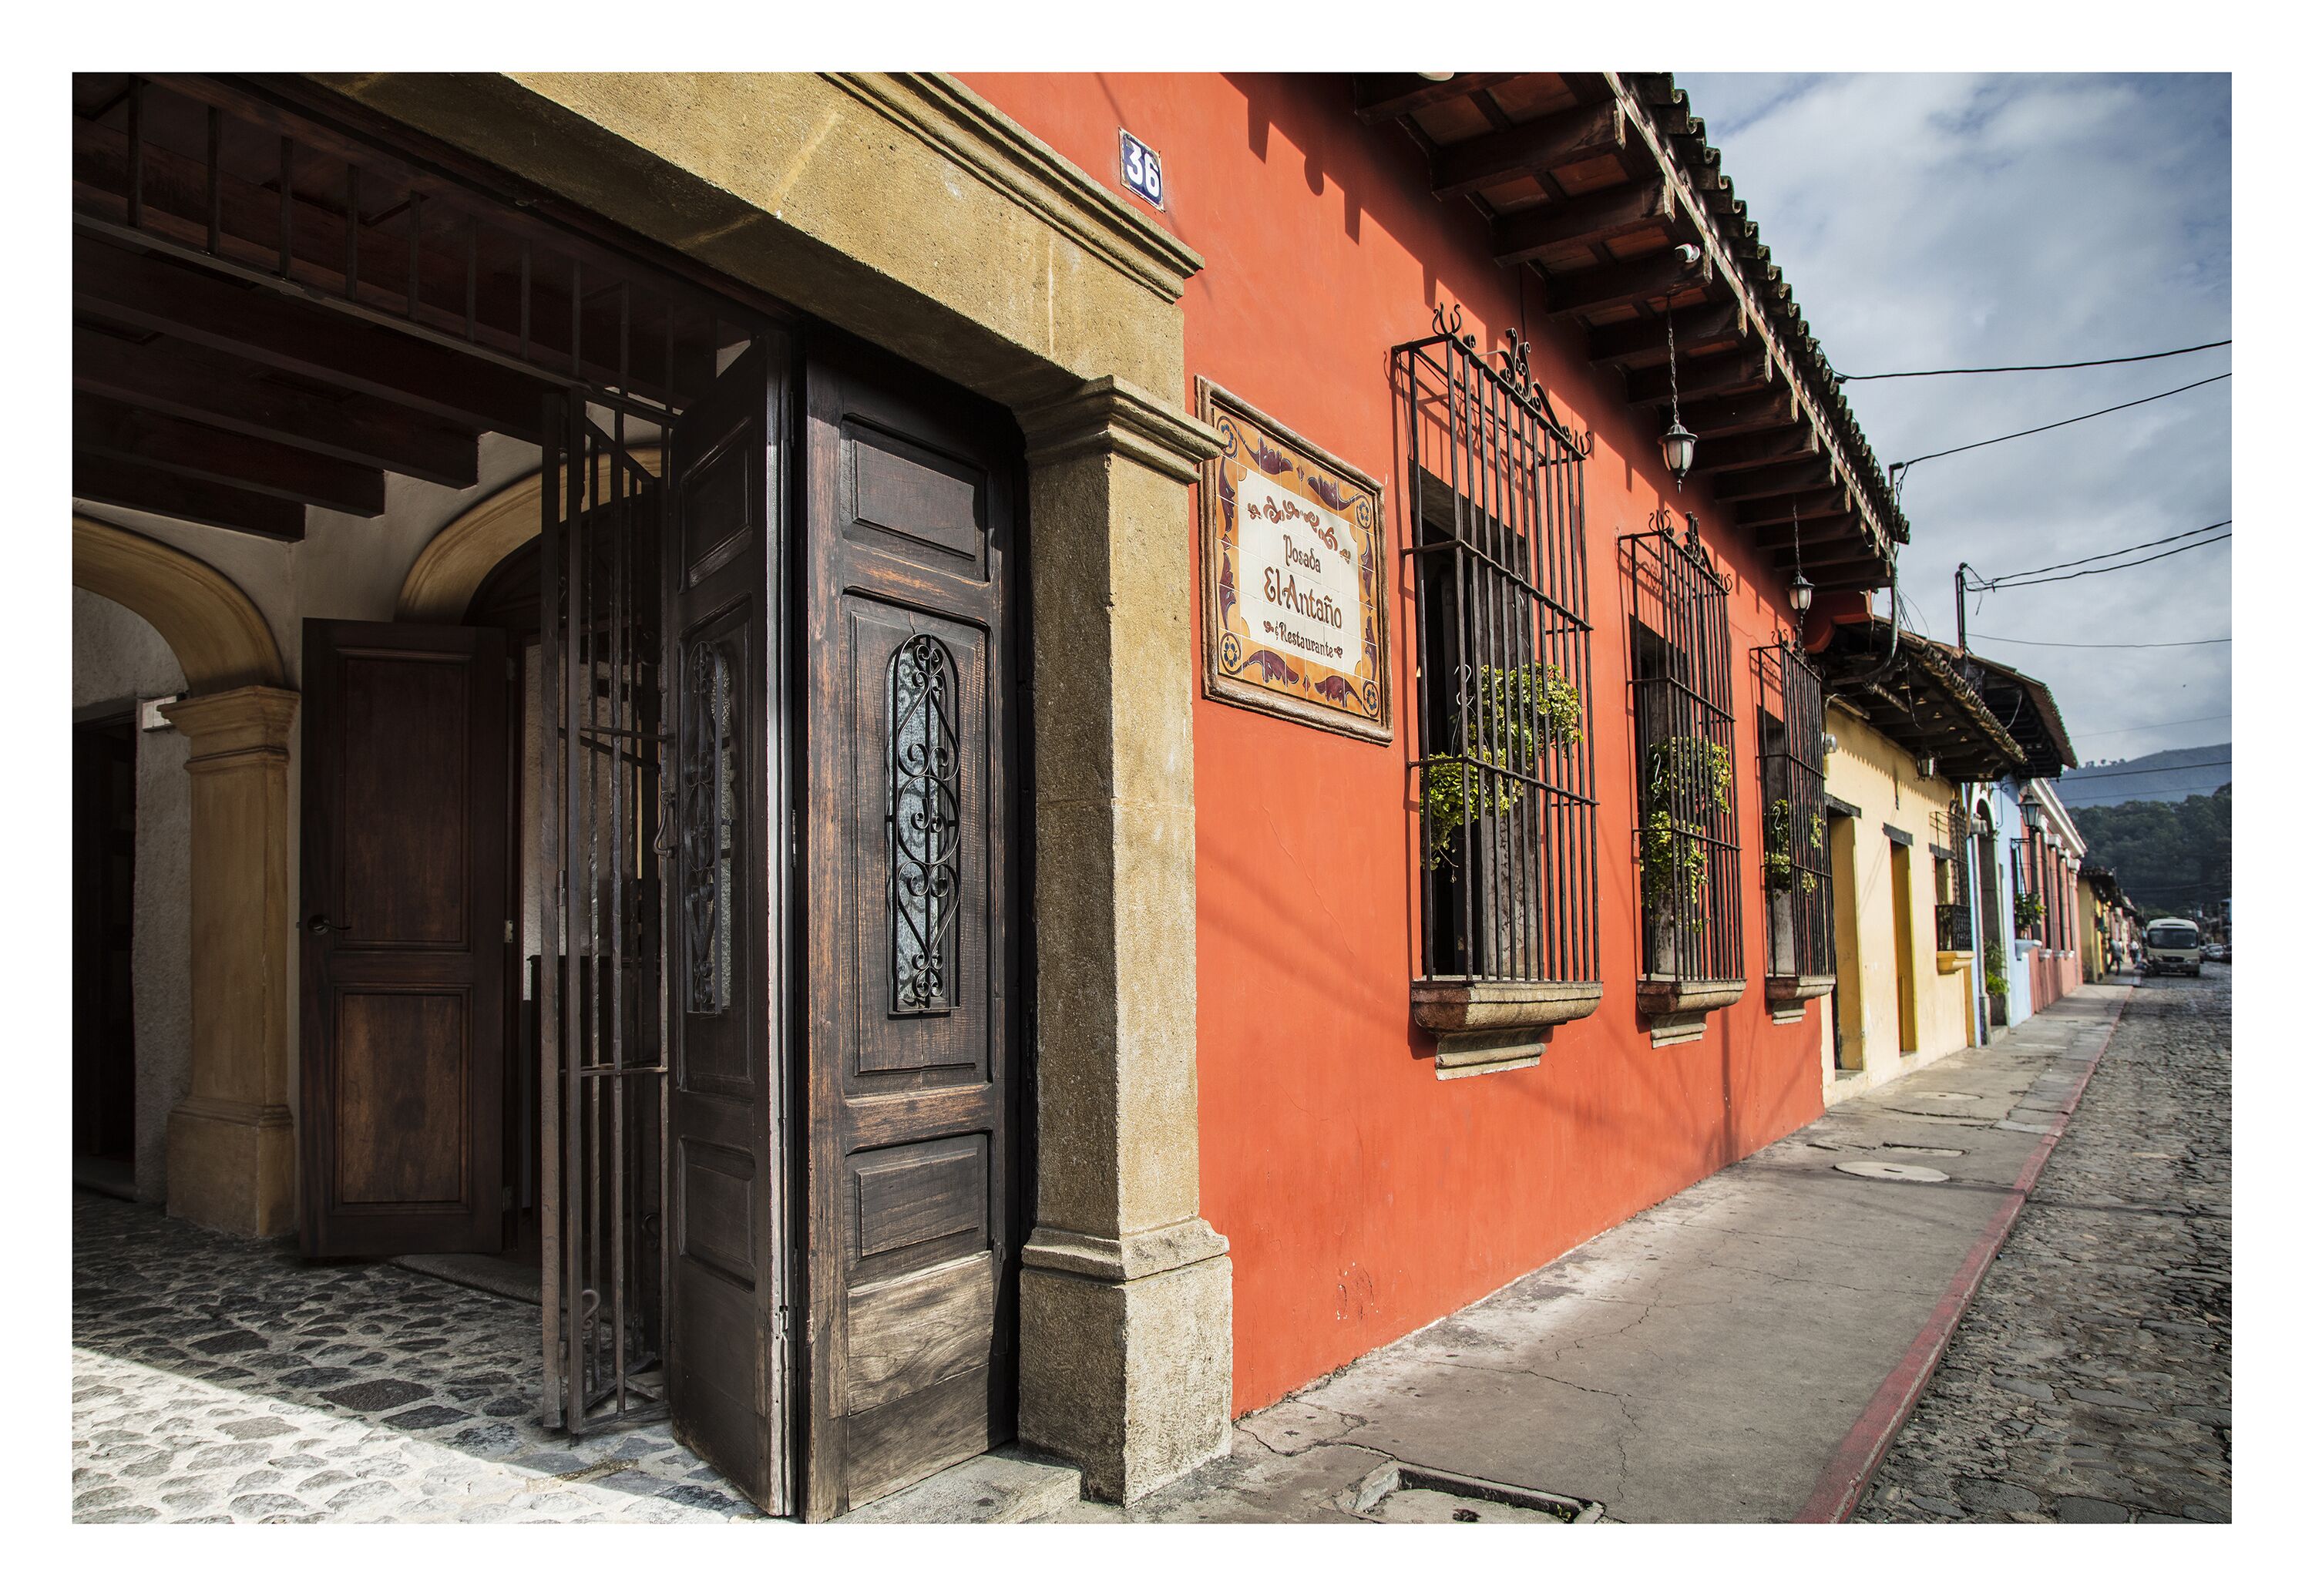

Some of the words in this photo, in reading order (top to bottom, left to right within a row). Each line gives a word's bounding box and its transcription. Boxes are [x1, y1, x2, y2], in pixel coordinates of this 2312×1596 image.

[1126, 139, 1161, 197] 36
[1283, 534, 1321, 573] Posada
[1264, 566, 1282, 606] El
[1282, 574, 1343, 630] Antaño
[1279, 622, 1334, 658] Restaurante
